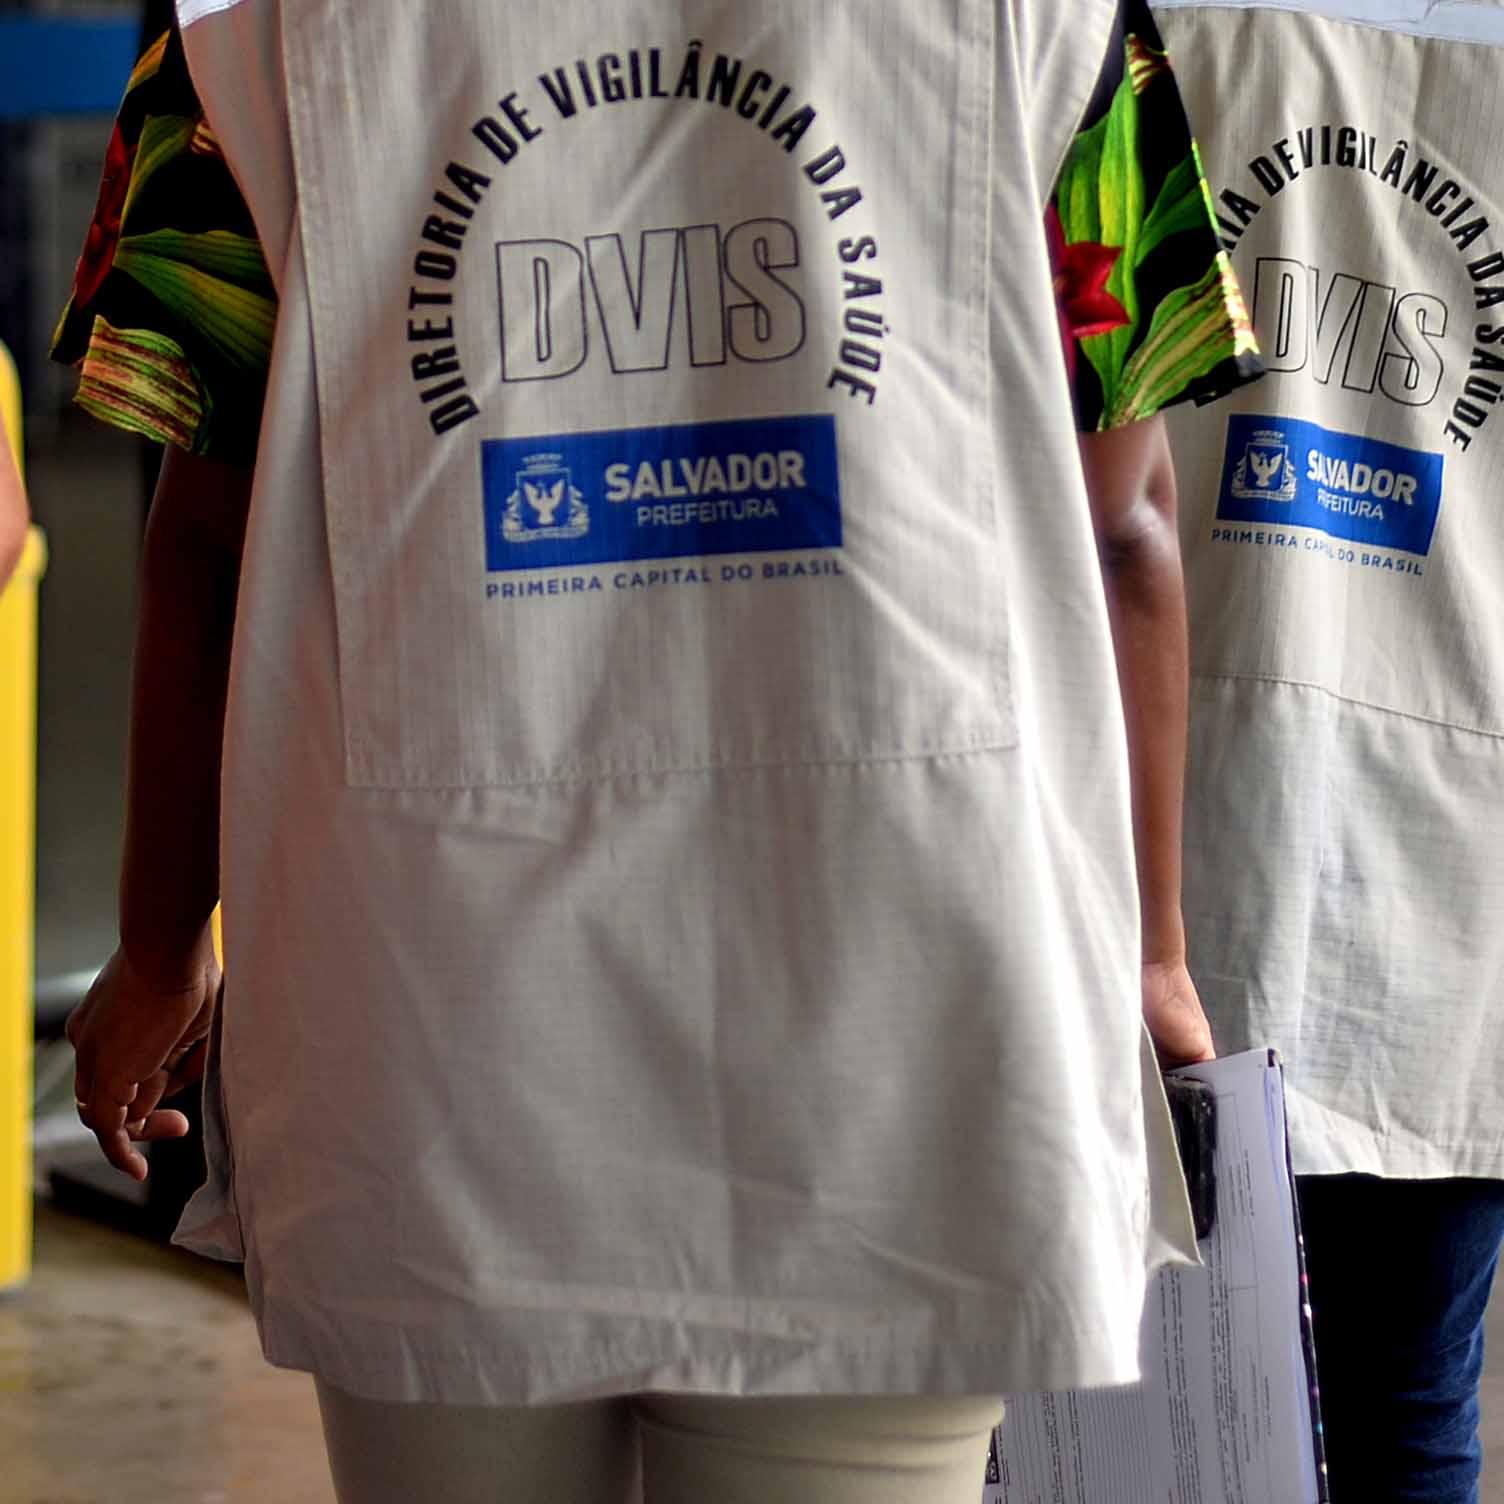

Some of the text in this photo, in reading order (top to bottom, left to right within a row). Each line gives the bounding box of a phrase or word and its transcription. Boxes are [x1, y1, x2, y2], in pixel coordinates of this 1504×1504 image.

[1249, 138, 1300, 197] DE
[408, 40, 892, 437] DIRETORIA DE VIGILÂNCIA DA SAÚDE
[494, 217, 808, 384] DVIS
[1251, 256, 1449, 408] DVIS
[605, 450, 806, 504] SALVADOR
[1307, 449, 1417, 506] SALVADOR
[637, 500, 779, 527] PREFEITURA
[486, 558, 846, 602] PRIMEIRA CAPITAL DO BRASIL
[1211, 528, 1299, 549] PRIMEIRA
[1360, 553, 1424, 577] BRASIL
